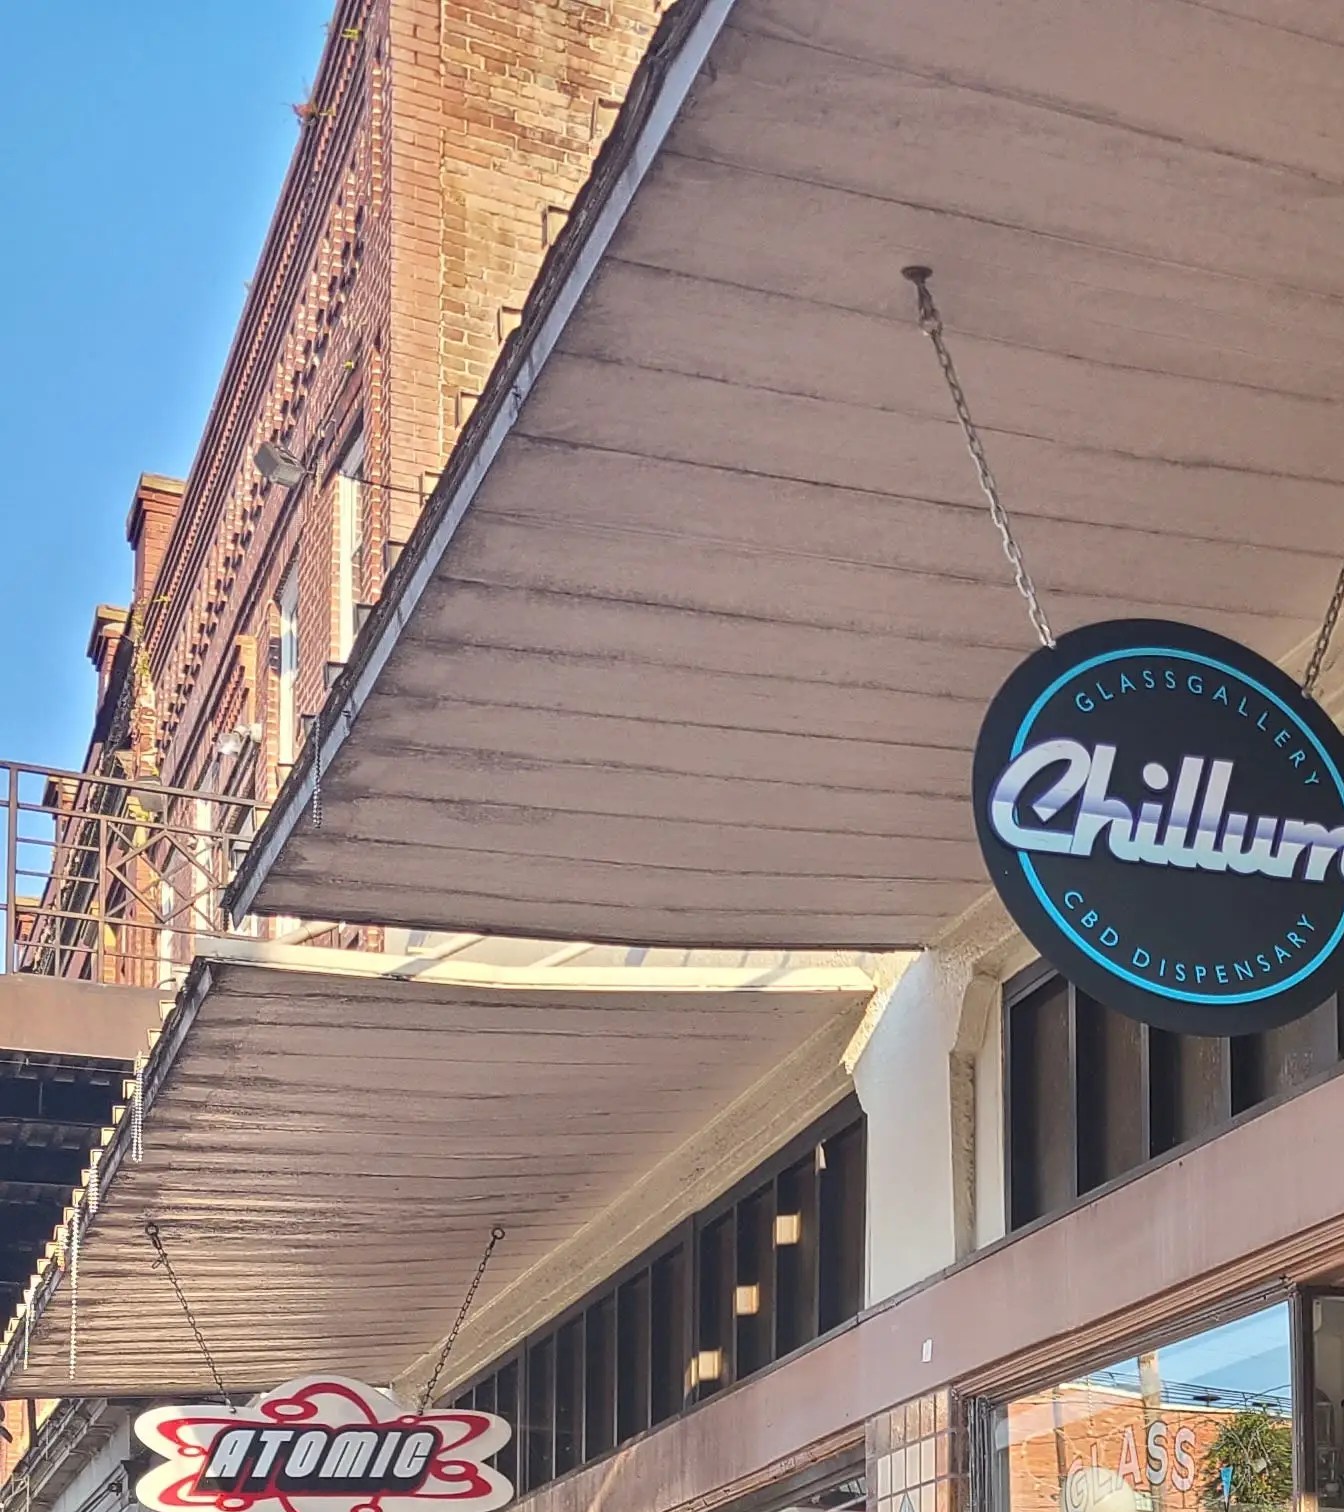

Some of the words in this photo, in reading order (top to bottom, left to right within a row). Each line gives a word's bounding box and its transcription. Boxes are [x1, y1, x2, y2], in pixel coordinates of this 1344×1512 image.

[1064, 890, 1119, 949] CBD
[1131, 913, 1317, 984] DISPENSARY
[205, 1430, 437, 1480] ATOMIC
